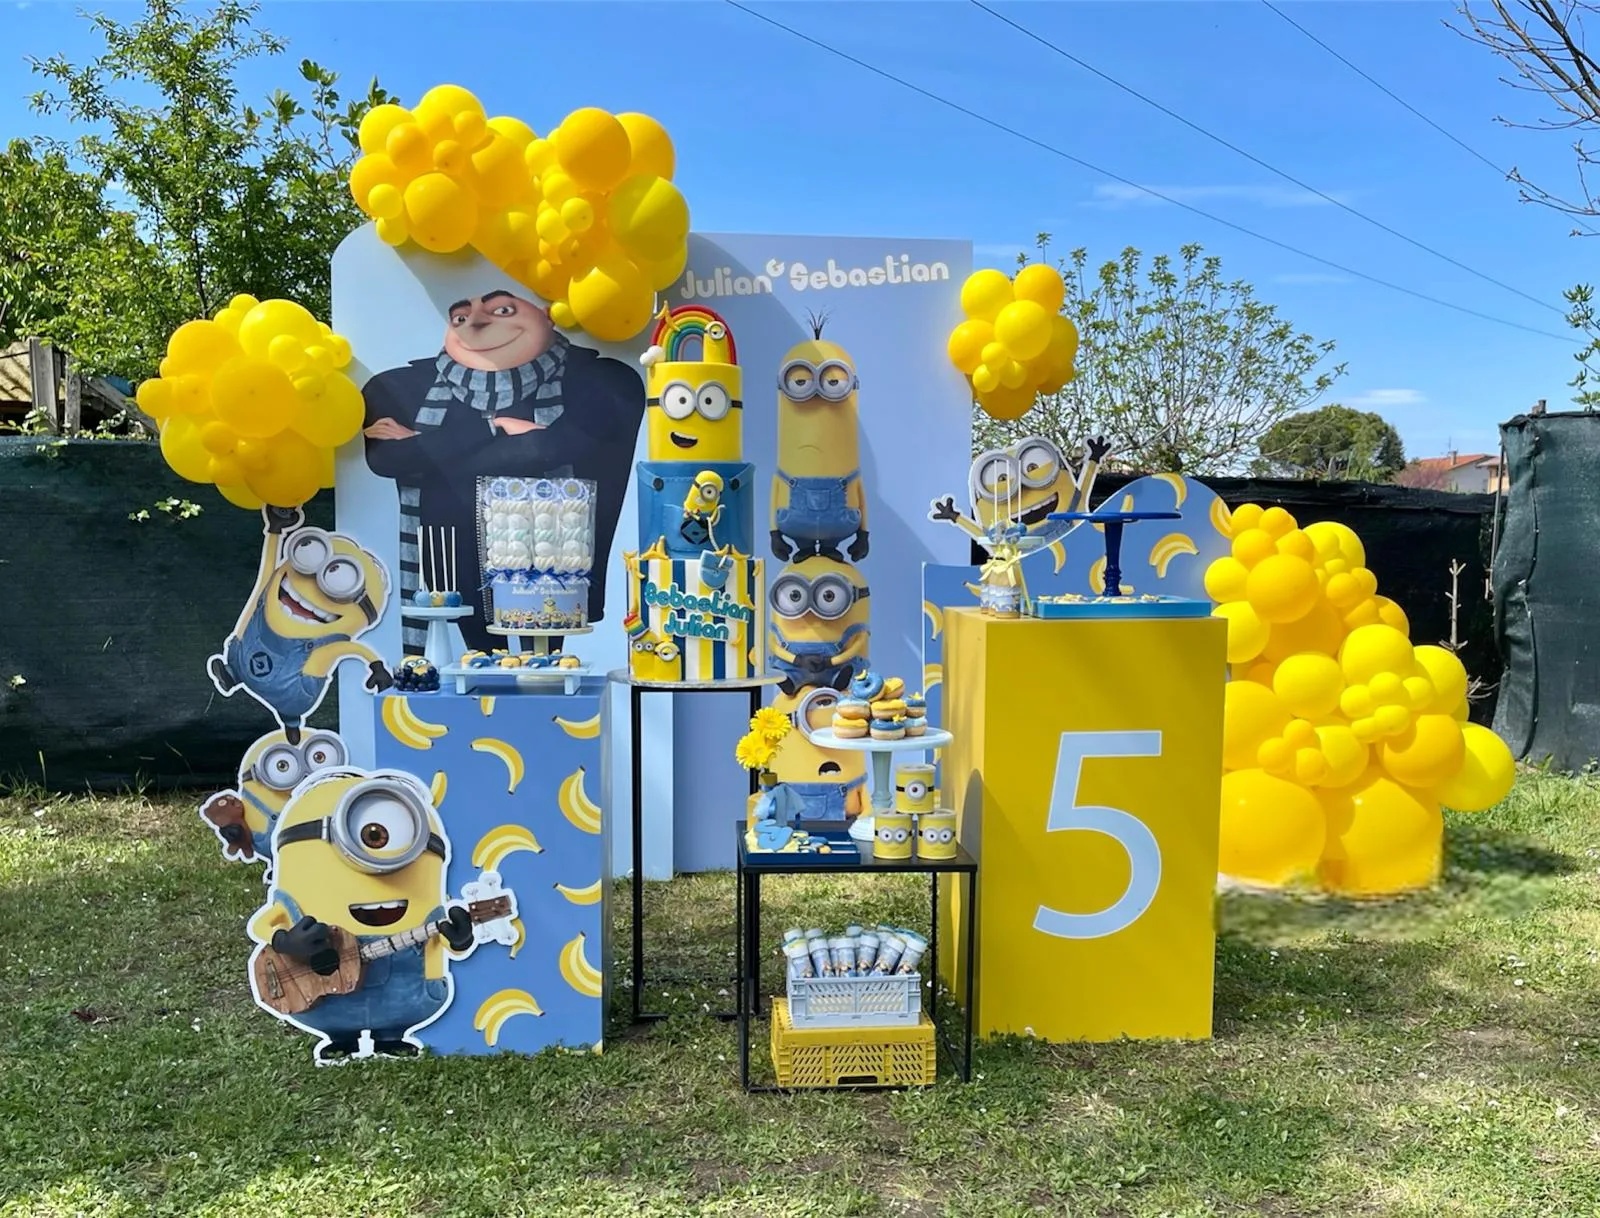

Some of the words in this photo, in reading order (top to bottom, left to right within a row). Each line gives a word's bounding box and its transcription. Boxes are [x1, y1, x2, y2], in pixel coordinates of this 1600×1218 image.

[681, 267, 772, 299] Julian
[790, 254, 949, 291] Sebastian
[644, 581, 751, 622] Sebastian
[664, 611, 729, 640] Julian
[1032, 730, 1162, 939] 5
